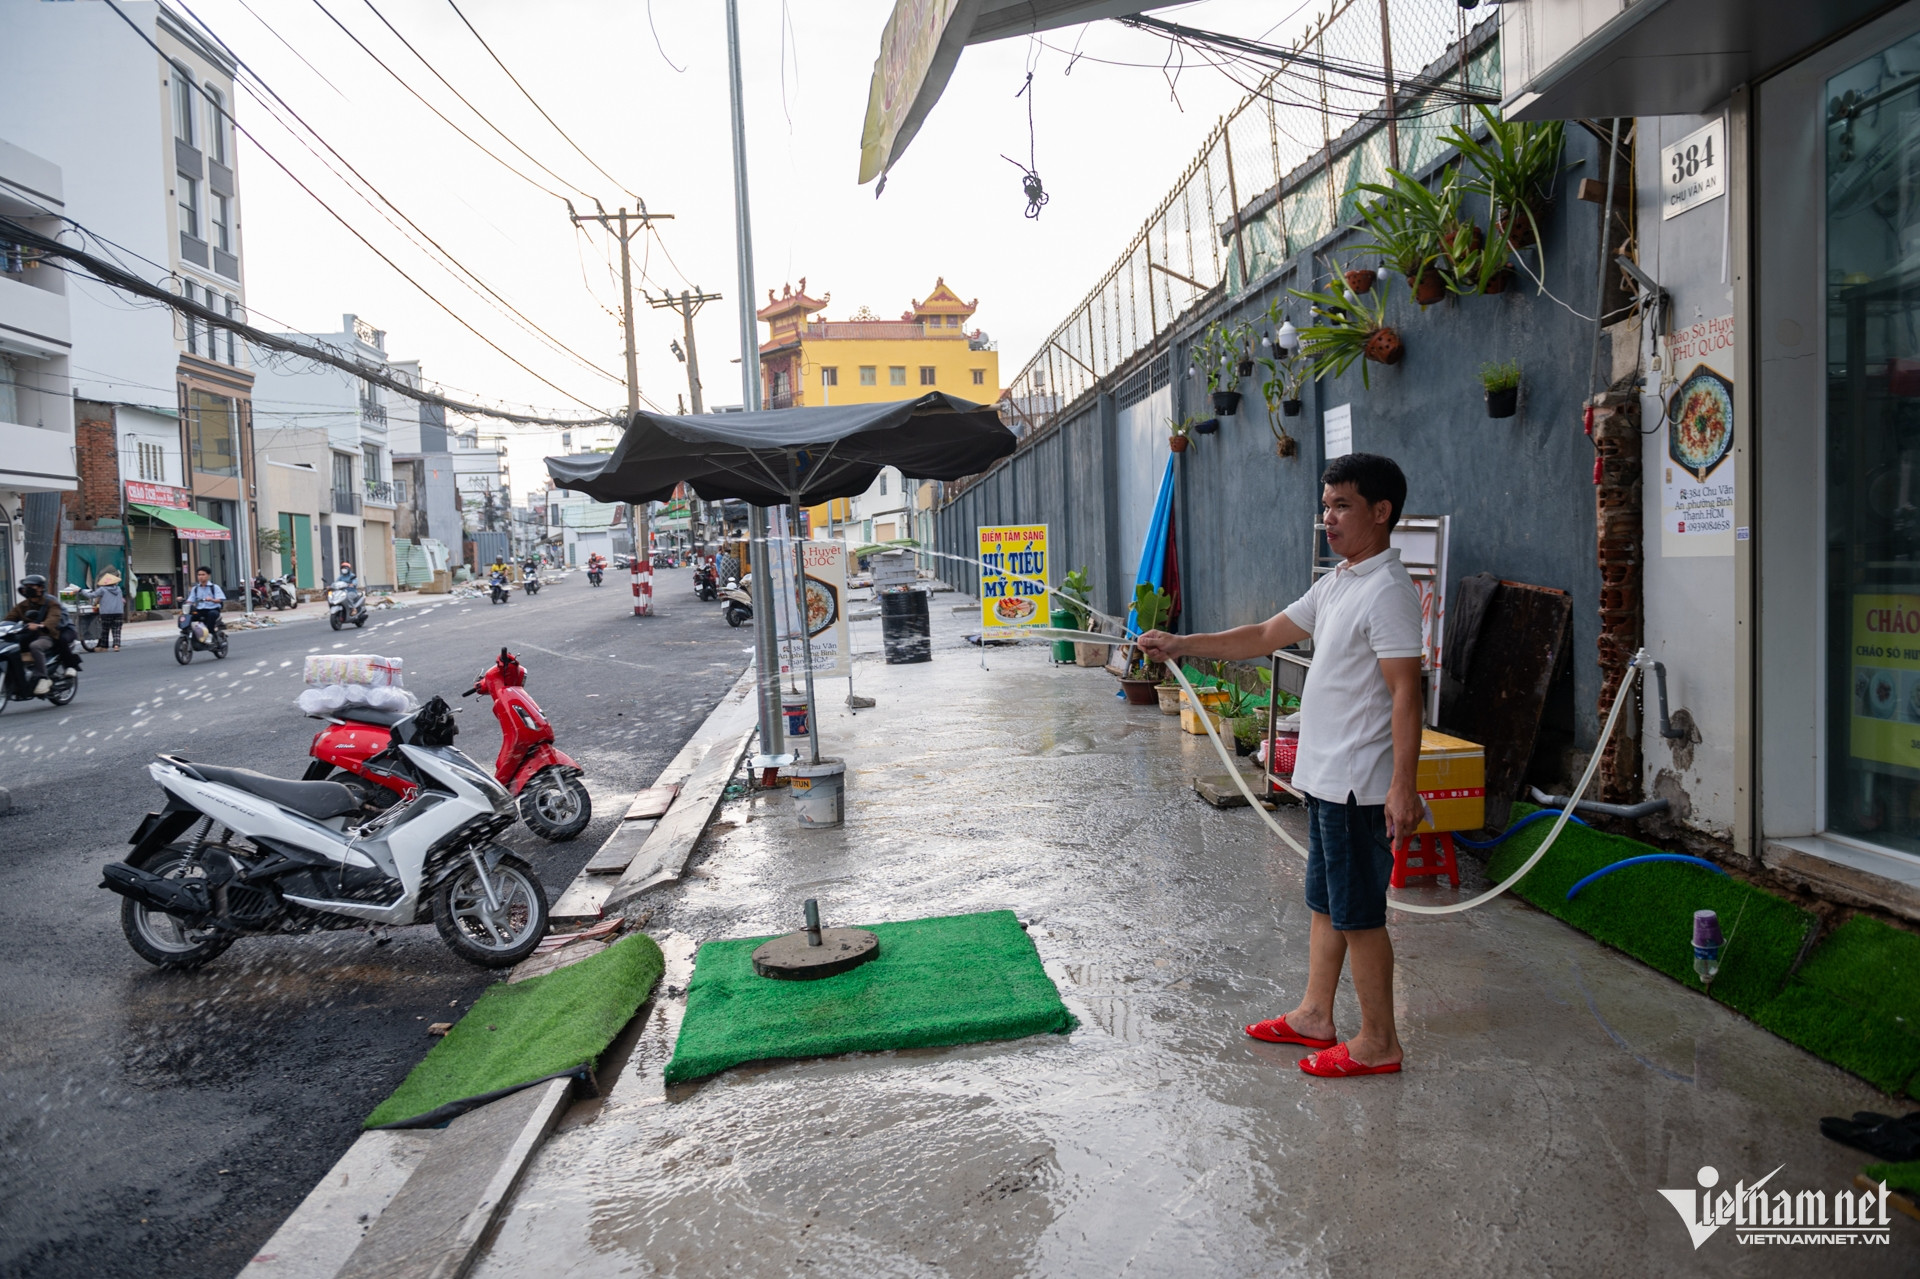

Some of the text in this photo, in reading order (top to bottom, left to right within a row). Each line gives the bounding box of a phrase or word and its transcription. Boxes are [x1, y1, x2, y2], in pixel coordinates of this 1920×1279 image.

[1671, 135, 1715, 185] 384
[1670, 175, 1717, 206] CHU VĂN AN
[1672, 339, 1696, 362] PHÚ
[1004, 530, 1020, 541] TÂM
[1023, 528, 1044, 541] SÁNG
[982, 540, 1045, 576] HỦ TIẾU
[983, 577, 1009, 598] MỸ
[1866, 605, 1920, 634] CHÁO
